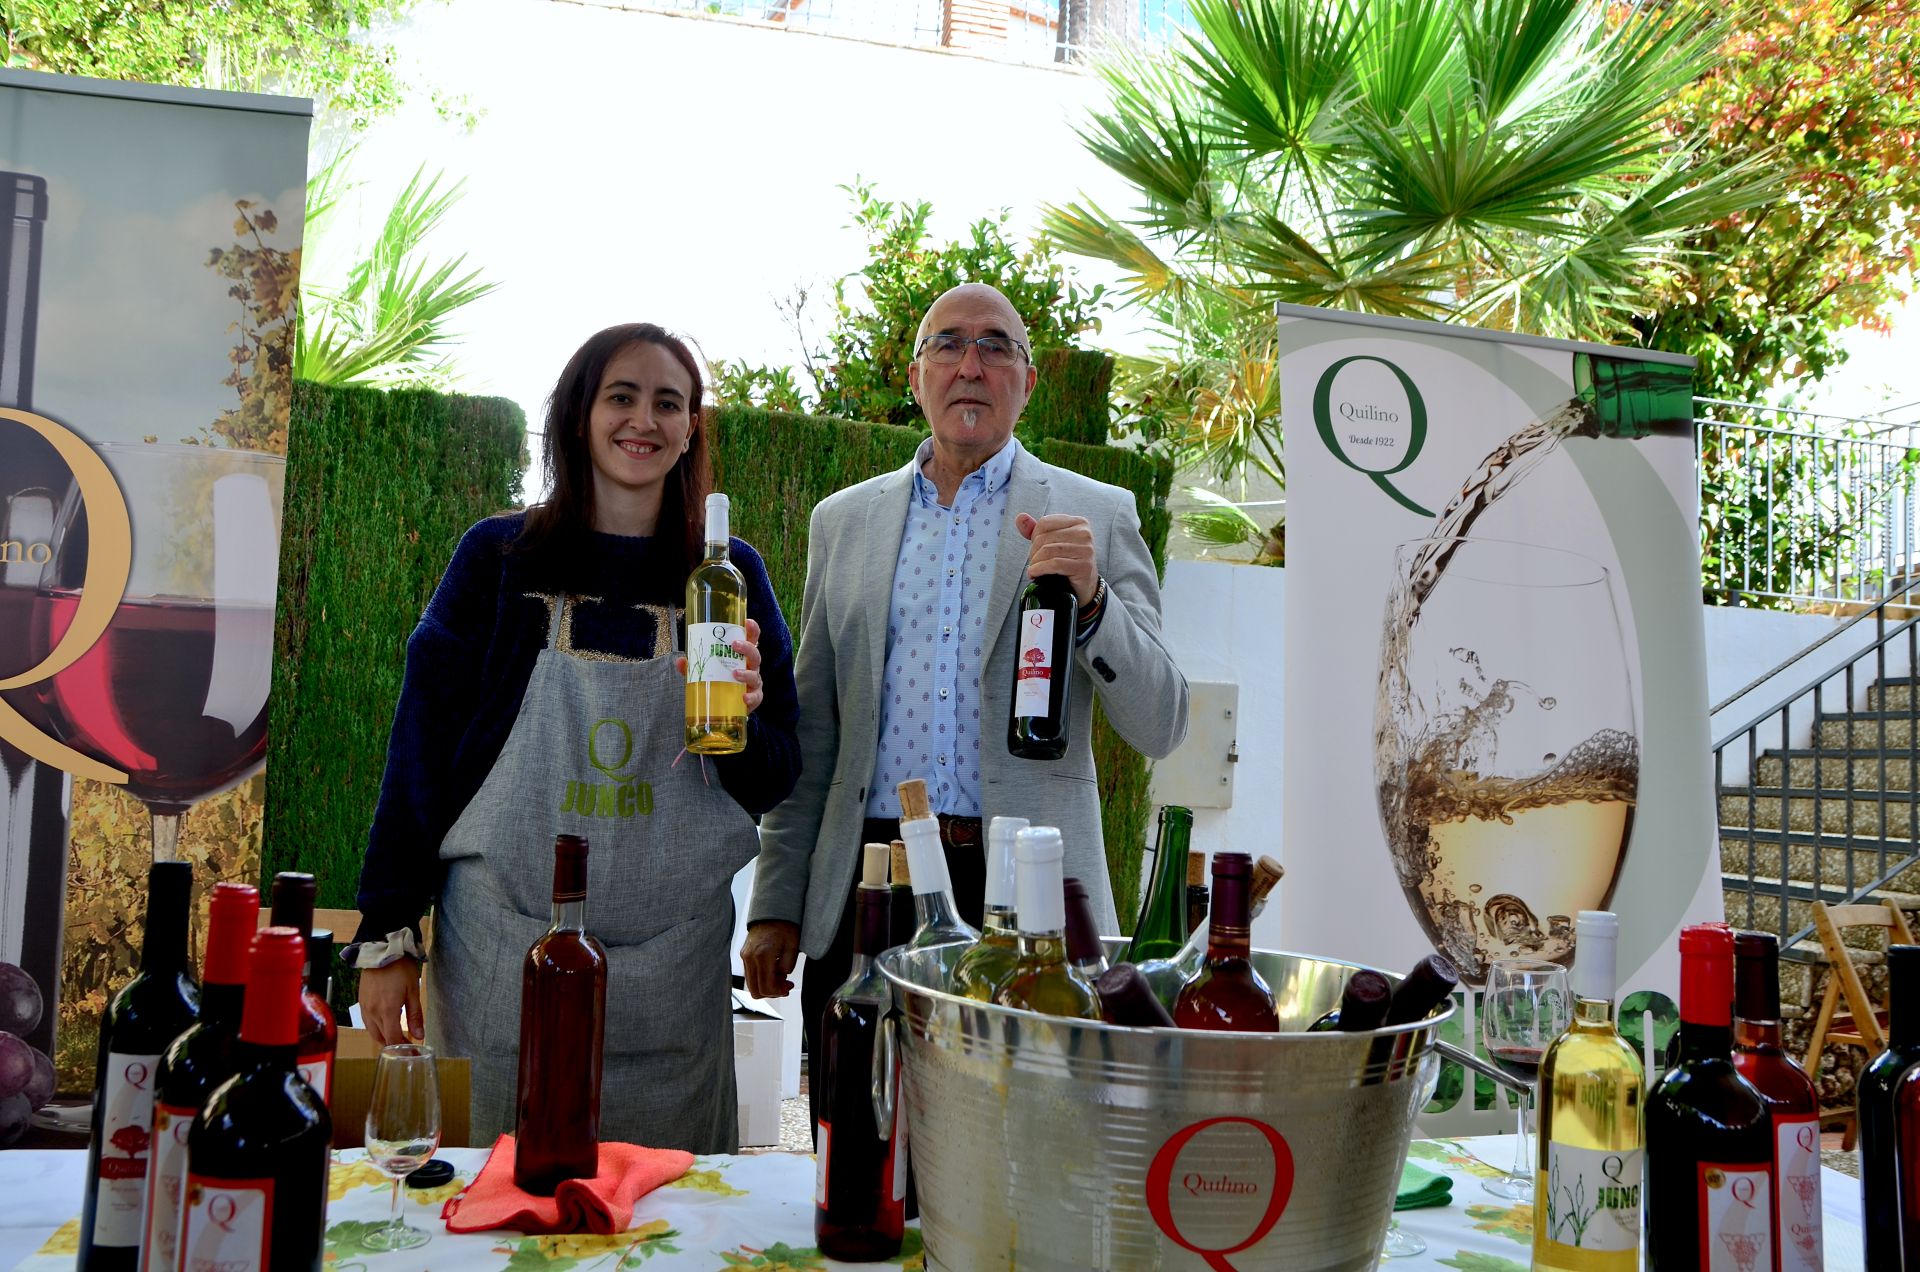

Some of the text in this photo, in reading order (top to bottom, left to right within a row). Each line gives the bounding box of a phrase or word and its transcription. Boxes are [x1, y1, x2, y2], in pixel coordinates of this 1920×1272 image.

[1339, 401, 1399, 423] Quilino
[1312, 355, 1437, 519] Q
[1348, 434, 1395, 447] Desde 1922
[713, 625, 726, 644] Q
[588, 717, 637, 783] Q
[560, 779, 655, 818] JUNCO
[125, 1062, 147, 1090] Q
[1797, 1126, 1814, 1153] Q
[1183, 1172, 1258, 1197] Quilino
[1602, 1155, 1624, 1185] Q
[1731, 1176, 1756, 1209] Q
[207, 1193, 237, 1233] Q
